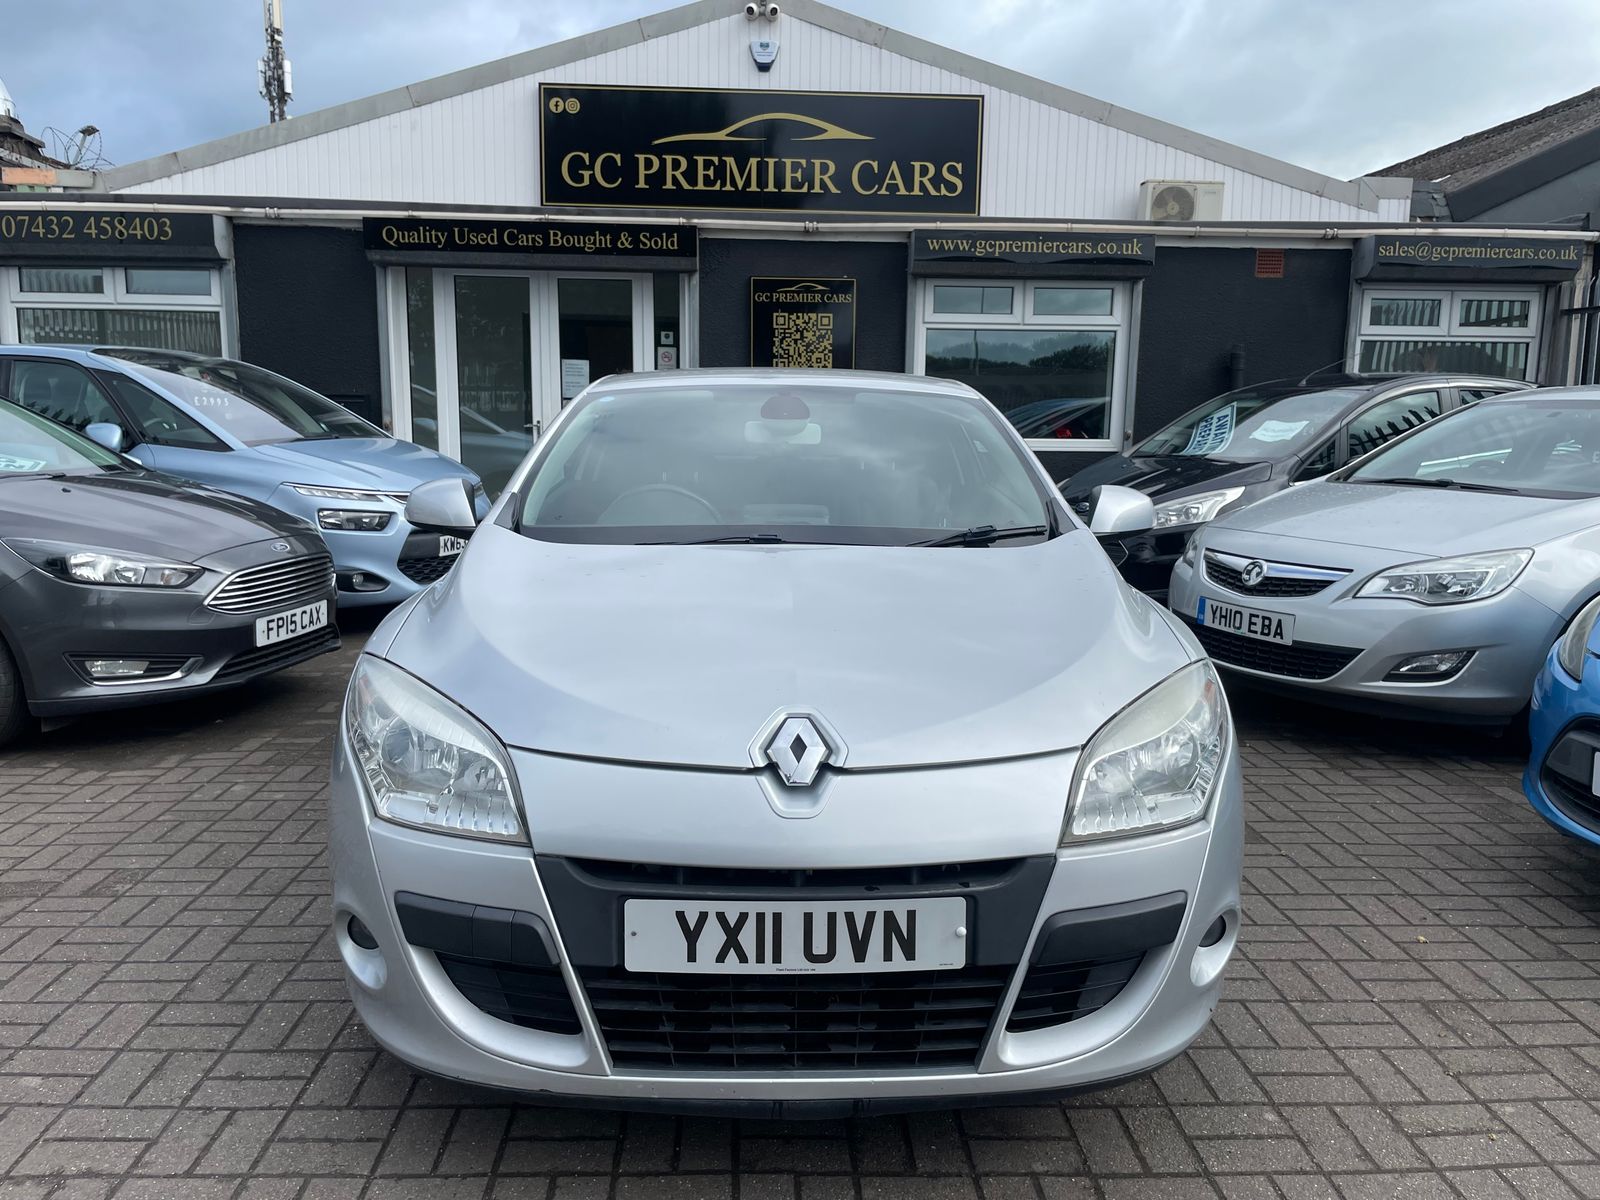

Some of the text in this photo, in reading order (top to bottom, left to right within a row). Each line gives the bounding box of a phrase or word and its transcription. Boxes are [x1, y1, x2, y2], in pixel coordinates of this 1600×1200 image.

[561, 151, 963, 197] GC PREMIER CARS
[1, 215, 173, 240] 07432 458403
[382, 225, 678, 252] Quality Used Cars Bought & Sold
[927, 236, 1142, 256] www.gcpremiercars.co.uk
[1378, 240, 1578, 262] sales@gcpremiercars.co.uk
[755, 292, 852, 303] GC PREMIER CARS
[266, 604, 321, 640] FP15 CAX
[1247, 612, 1284, 640] EBA
[675, 909, 916, 964] YX11 UVN
